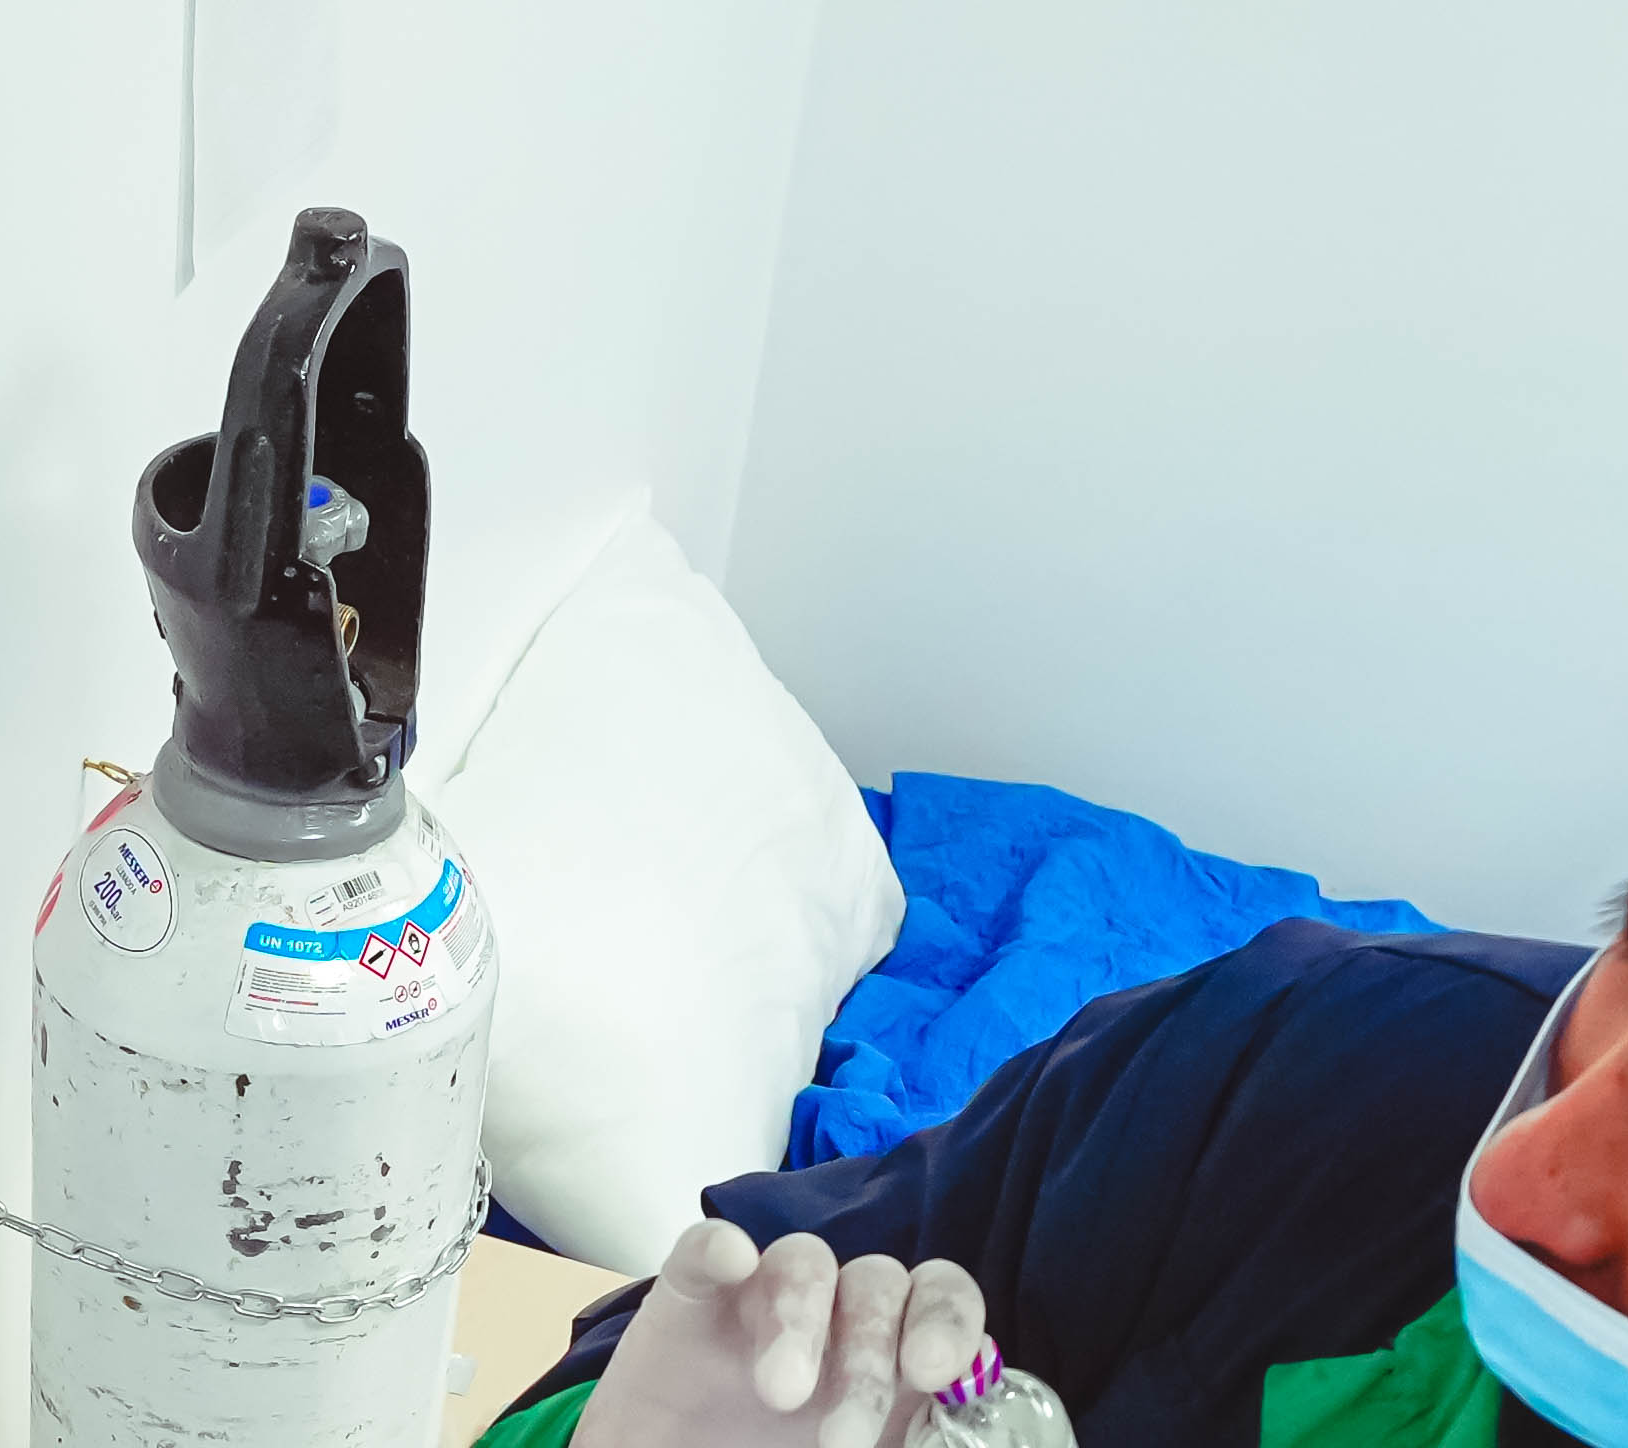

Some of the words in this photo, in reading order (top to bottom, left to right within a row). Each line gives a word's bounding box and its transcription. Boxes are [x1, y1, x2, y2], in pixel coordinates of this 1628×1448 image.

[117, 842, 151, 889] MESSER
[258, 934, 283, 950] UN
[287, 940, 324, 954] 1072
[385, 1007, 431, 1032] MESSER
